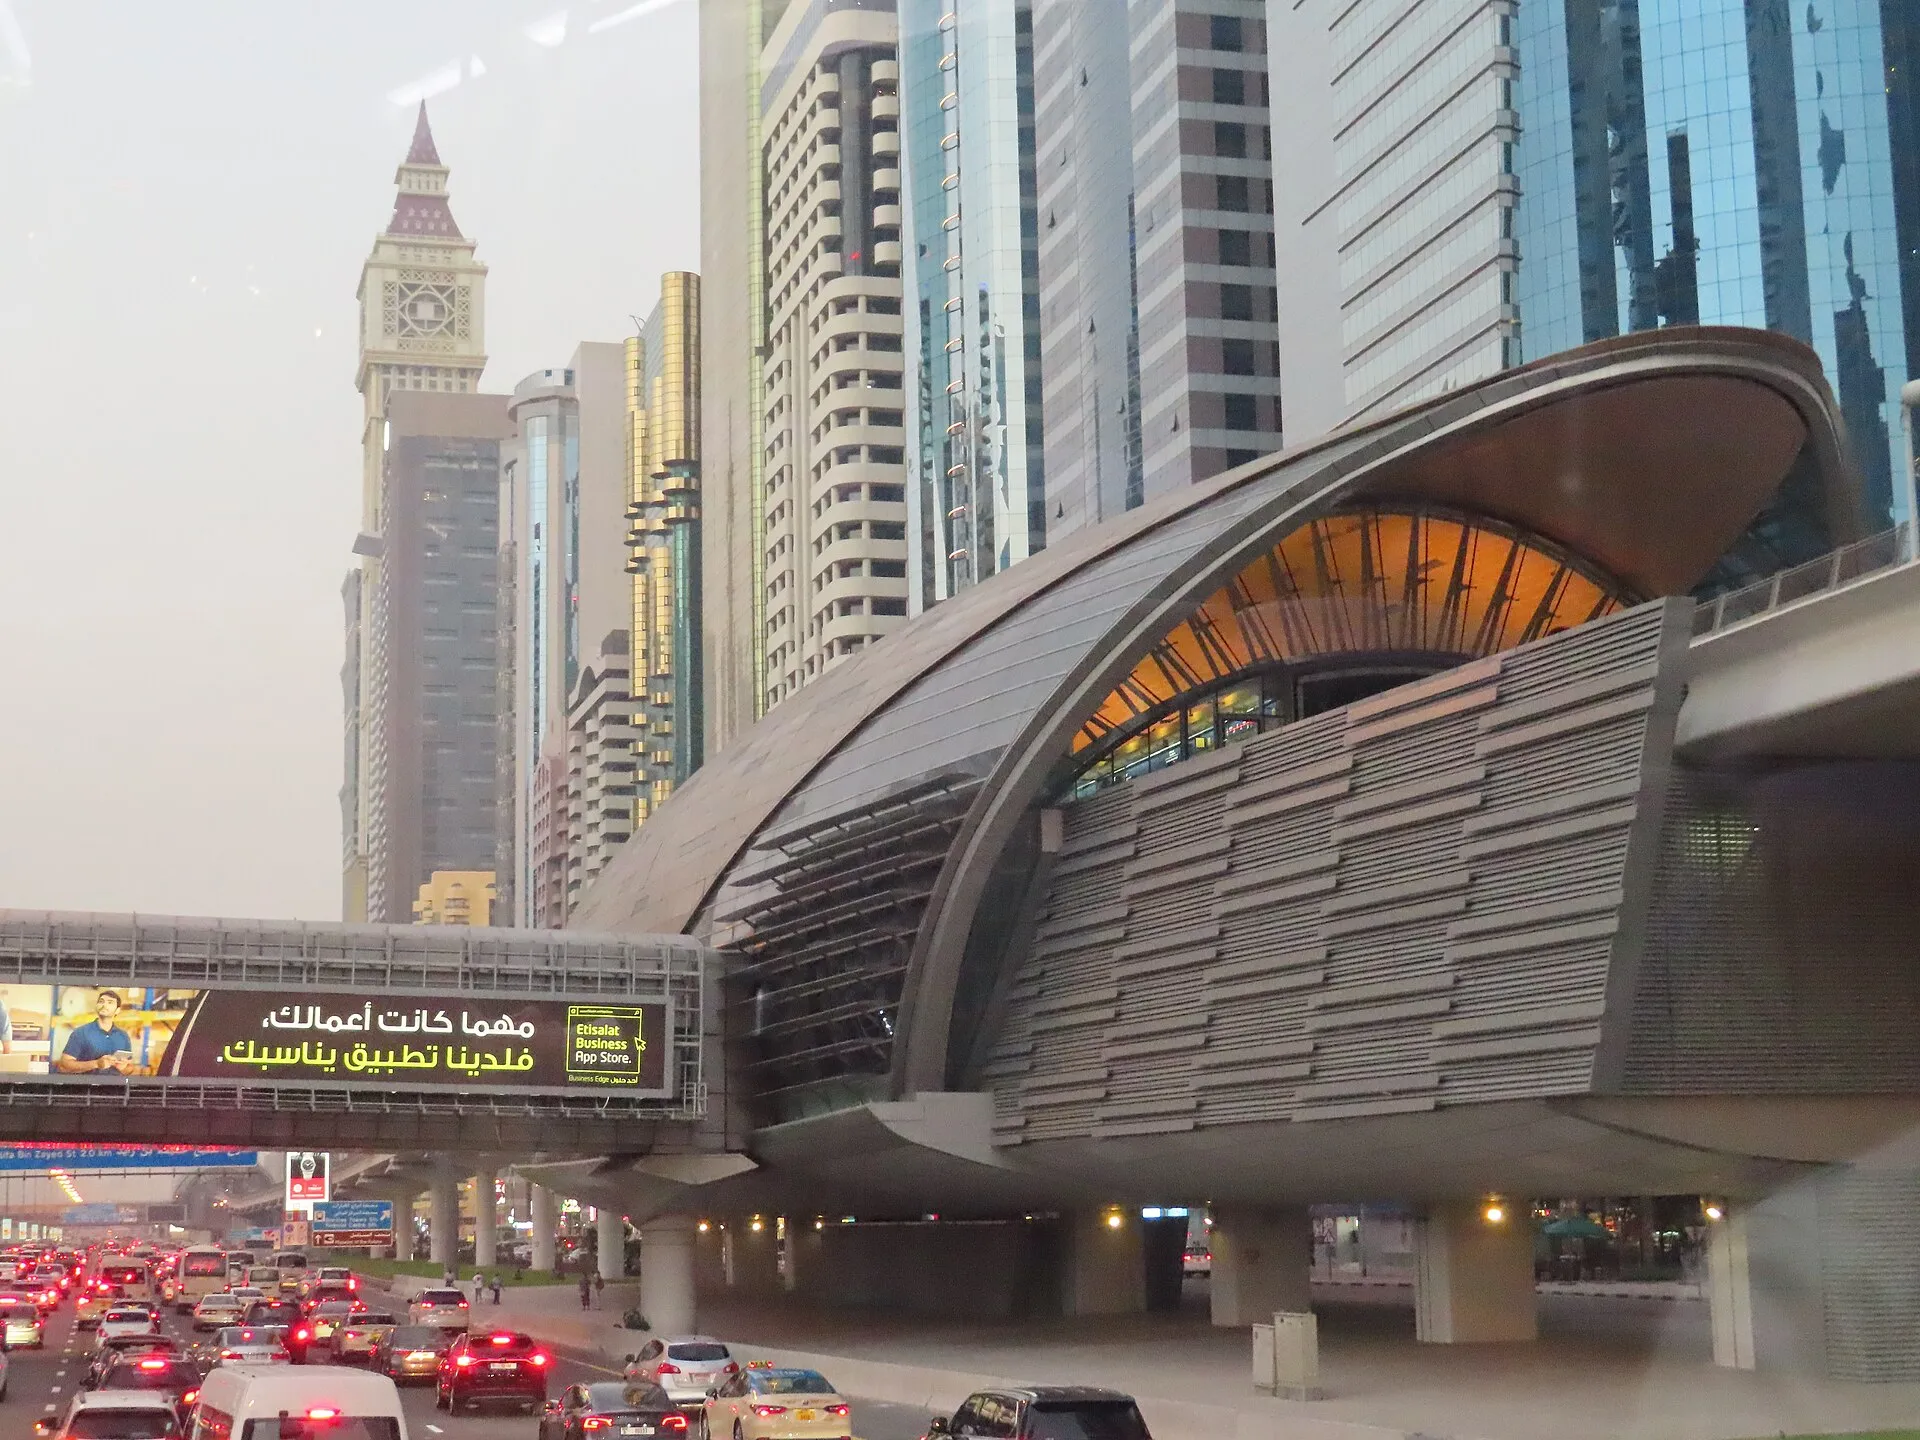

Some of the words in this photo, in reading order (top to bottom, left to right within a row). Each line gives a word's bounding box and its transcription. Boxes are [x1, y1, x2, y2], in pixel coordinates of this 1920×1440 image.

[262, 1001, 372, 1033] أعمالك،
[377, 1009, 453, 1034] كانت
[461, 1011, 535, 1039] مهما
[576, 1023, 620, 1036] Etisalat
[216, 1039, 337, 1073] يناسبك.
[575, 1037, 628, 1050] Business
[344, 1042, 439, 1074] تطبيق
[446, 1045, 534, 1077] فلدينا
[575, 1050, 597, 1064] App
[600, 1051, 632, 1064] Store.
[594, 1075, 609, 1084] Edge
[17, 1150, 32, 1159] Bin
[35, 1150, 63, 1160] Zayed
[66, 1149, 77, 1158] St
[98, 1148, 113, 1157] km
